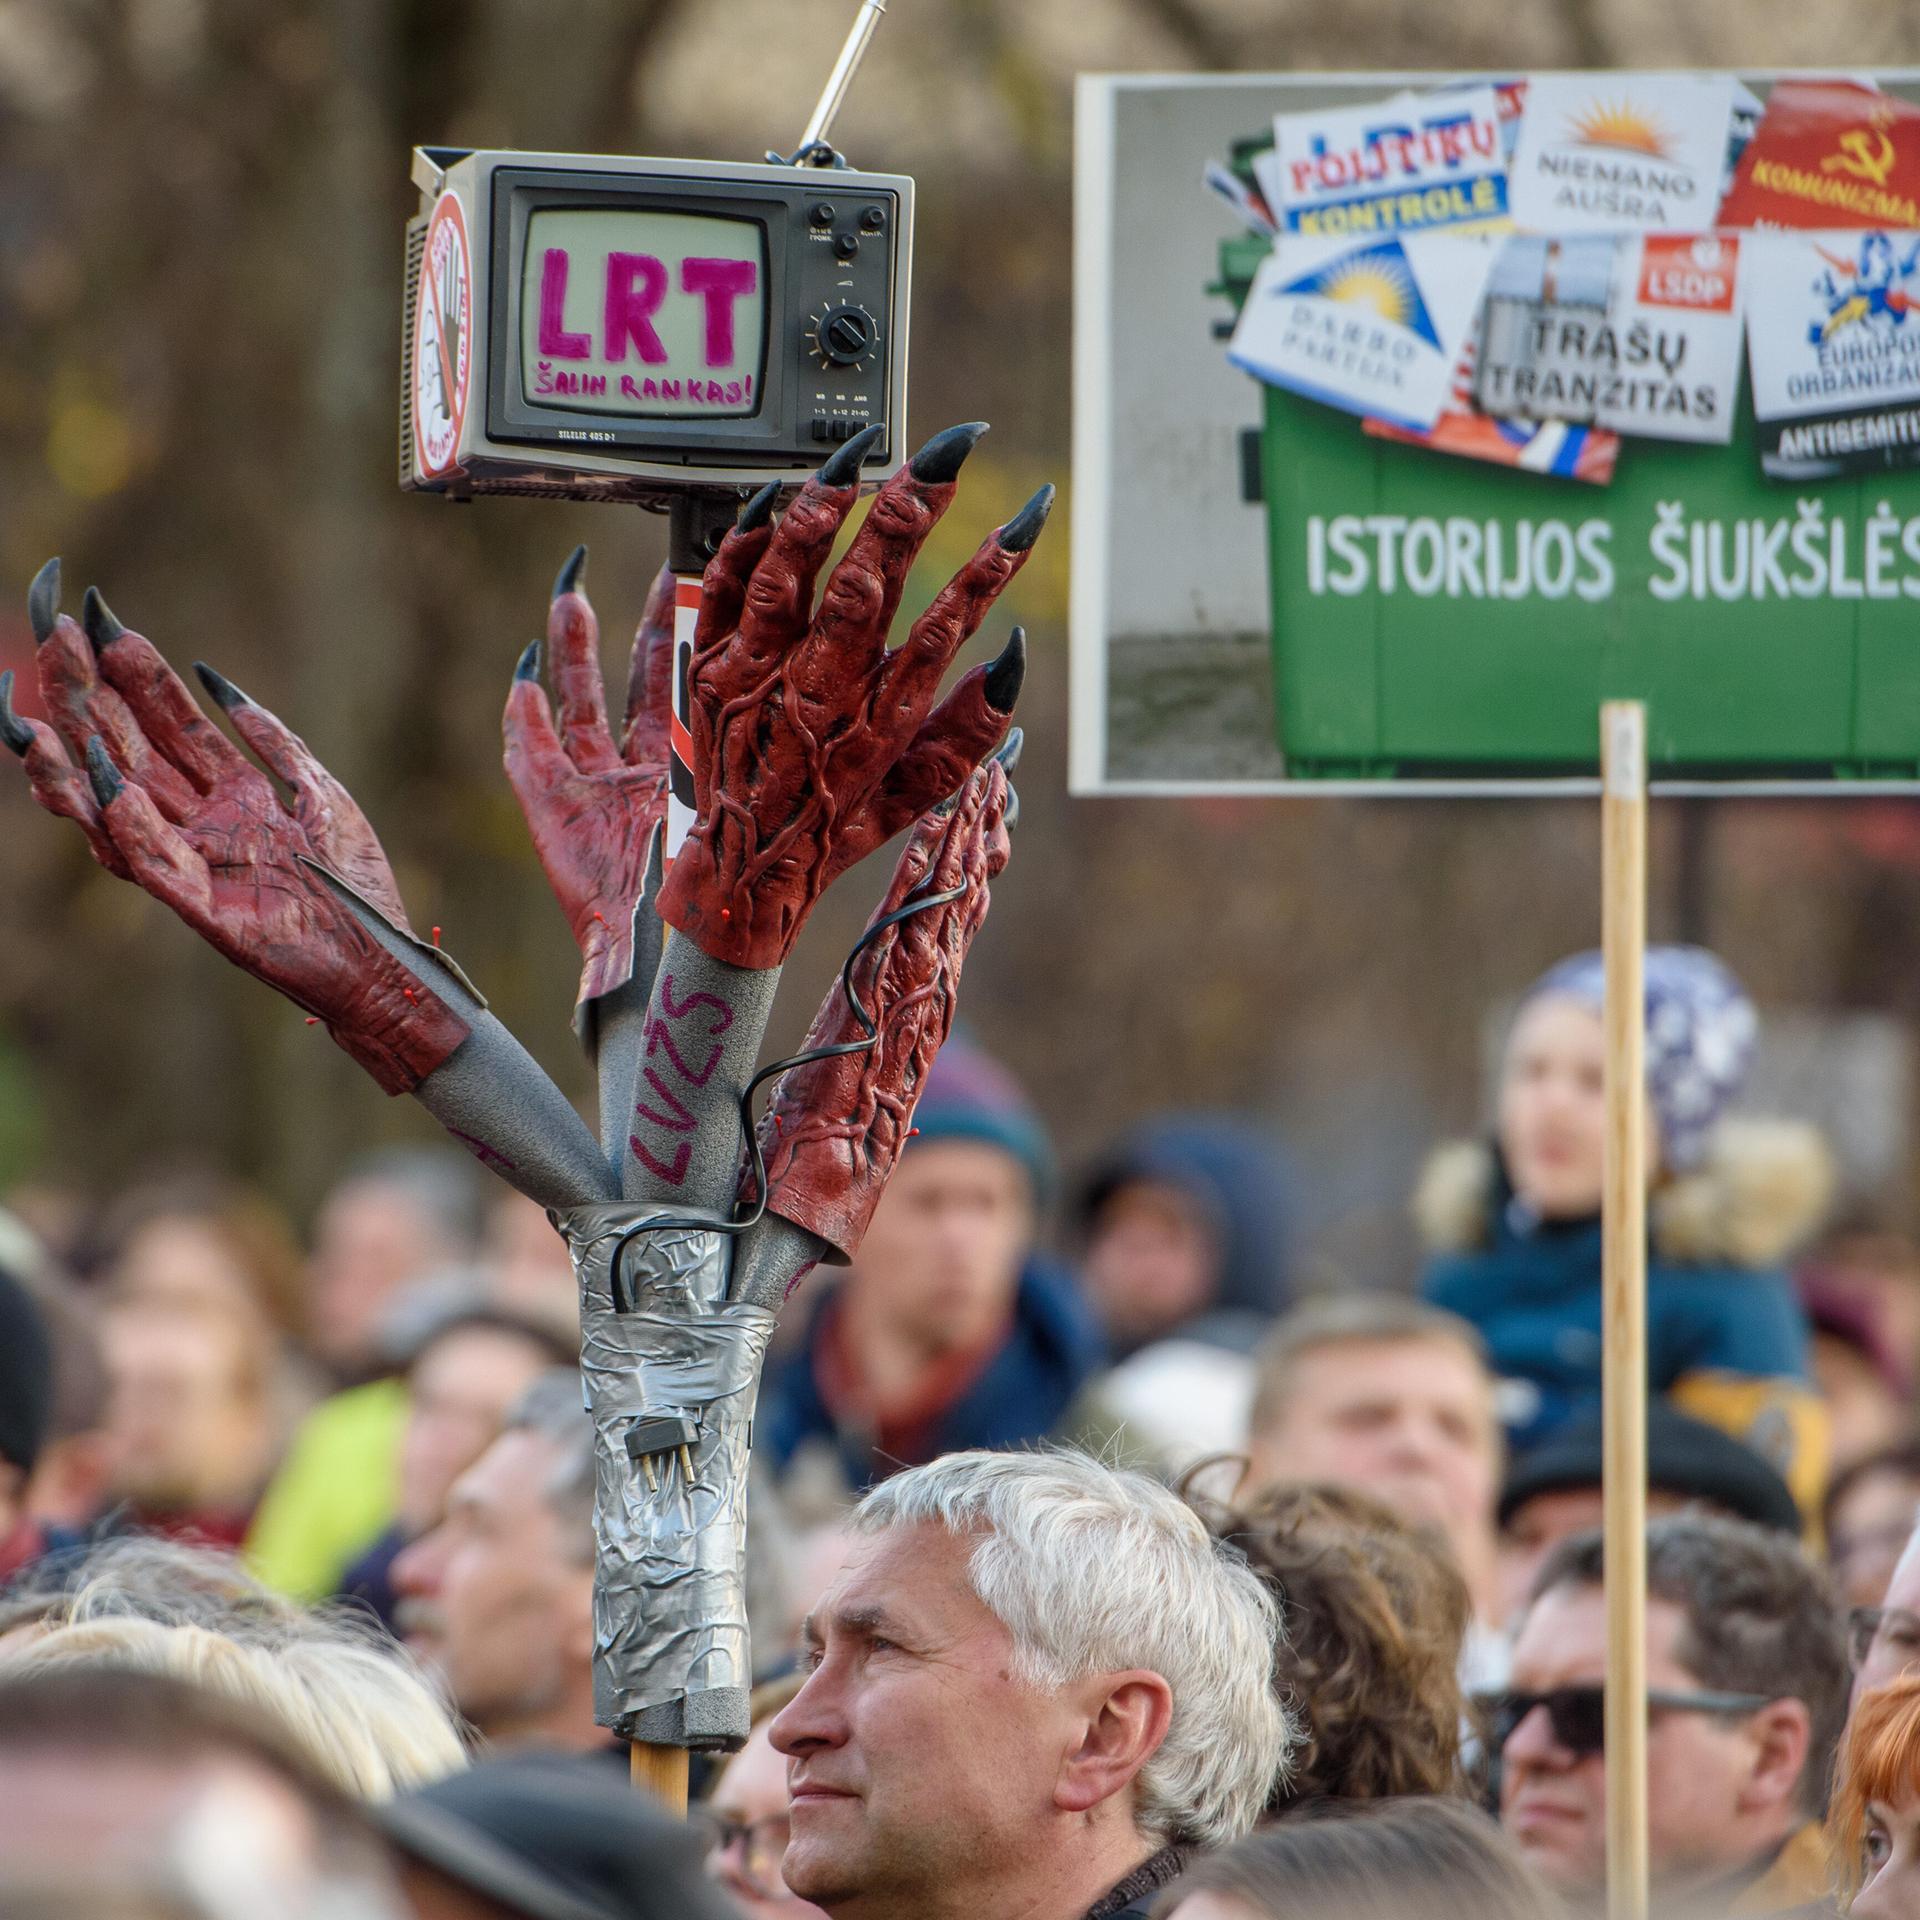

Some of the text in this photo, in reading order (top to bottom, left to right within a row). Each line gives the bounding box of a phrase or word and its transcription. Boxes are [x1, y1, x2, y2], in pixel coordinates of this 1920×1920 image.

[1536, 151, 1697, 203] NIEMANO
[1752, 158, 1920, 229] KOMUNIZMA
[1554, 185, 1667, 225] AUŠRA
[537, 248, 757, 367] LRT
[1817, 334, 1920, 368] EUROPO
[534, 361, 752, 405] ŠALIN RANKAS!
[1491, 364, 1718, 420] TRANZITAS
[1787, 361, 1920, 402] ORBANIZA
[1778, 408, 1920, 460] ANTISEMITI
[1306, 514, 1615, 601] ISTORIJOS
